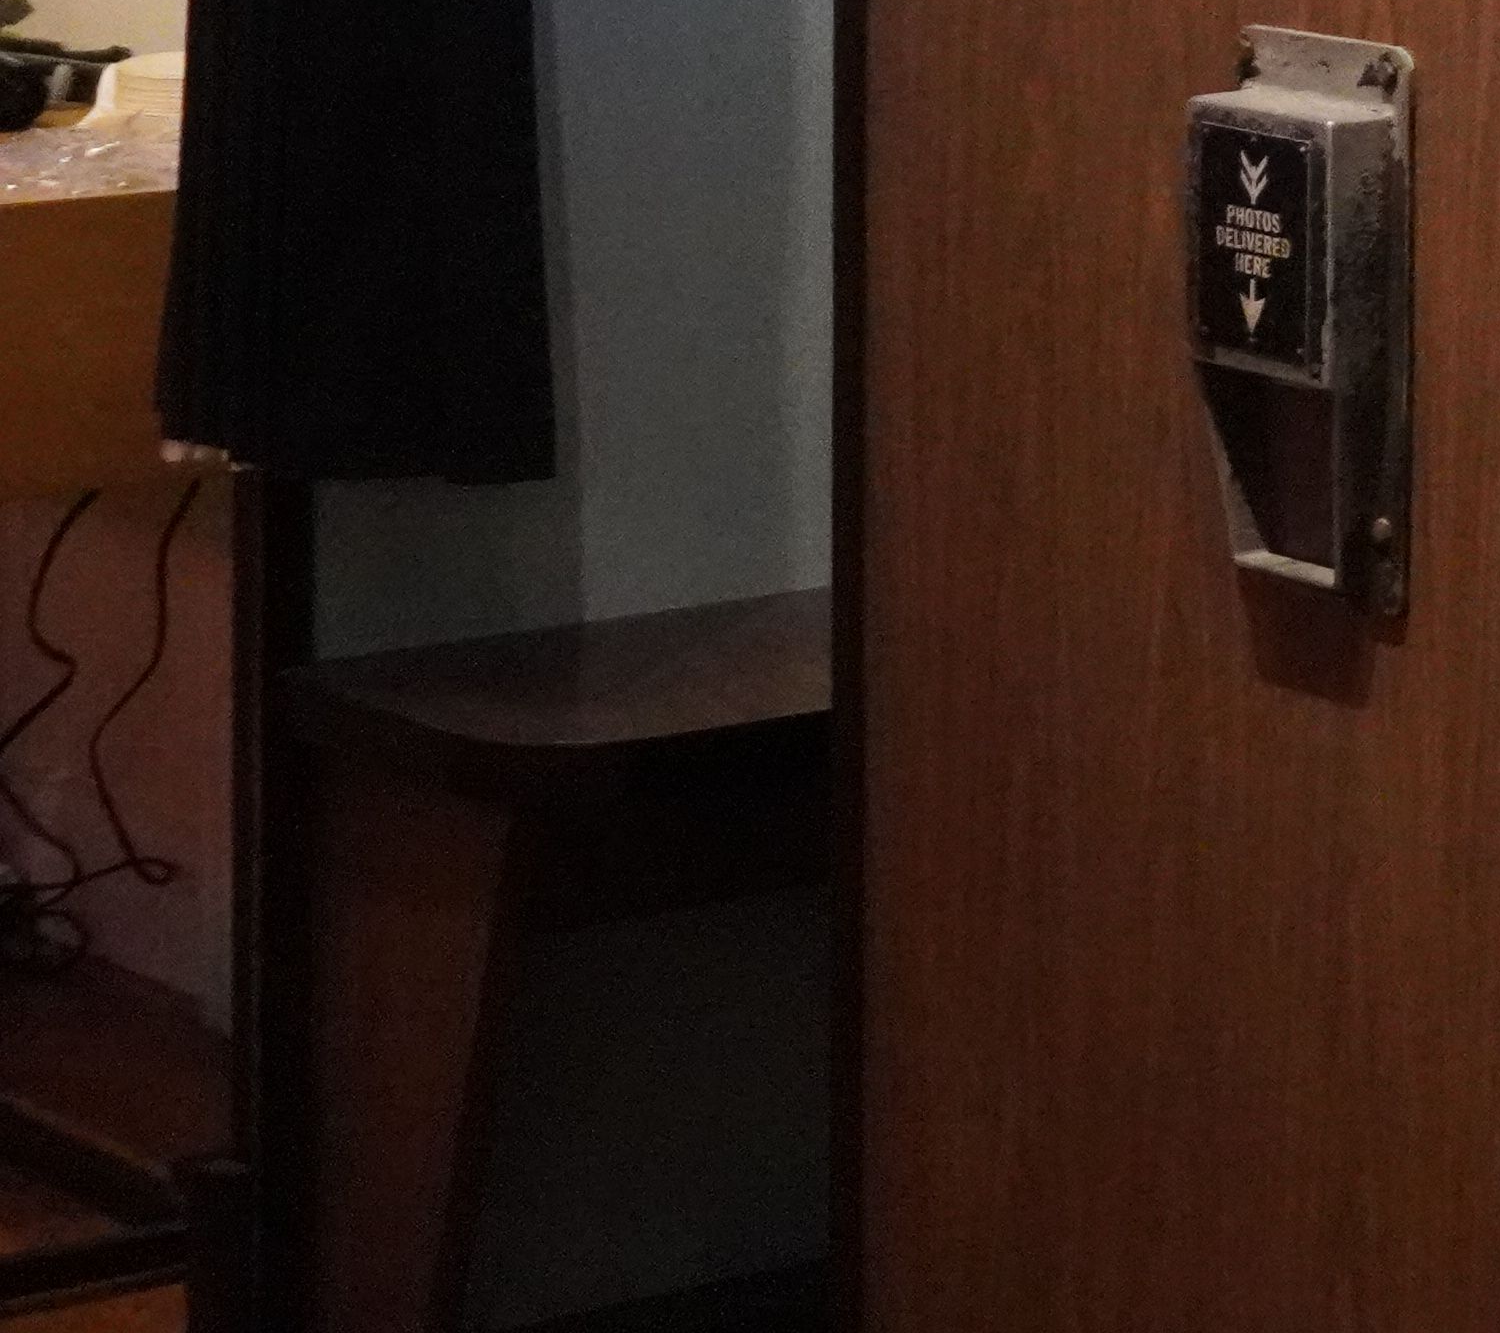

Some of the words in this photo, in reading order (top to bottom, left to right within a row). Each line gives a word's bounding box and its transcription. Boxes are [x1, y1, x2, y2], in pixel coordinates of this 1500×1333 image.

[1226, 204, 1282, 233] PHOTOS
[1216, 225, 1291, 258] DELIVERED
[1235, 252, 1272, 278] HERE
